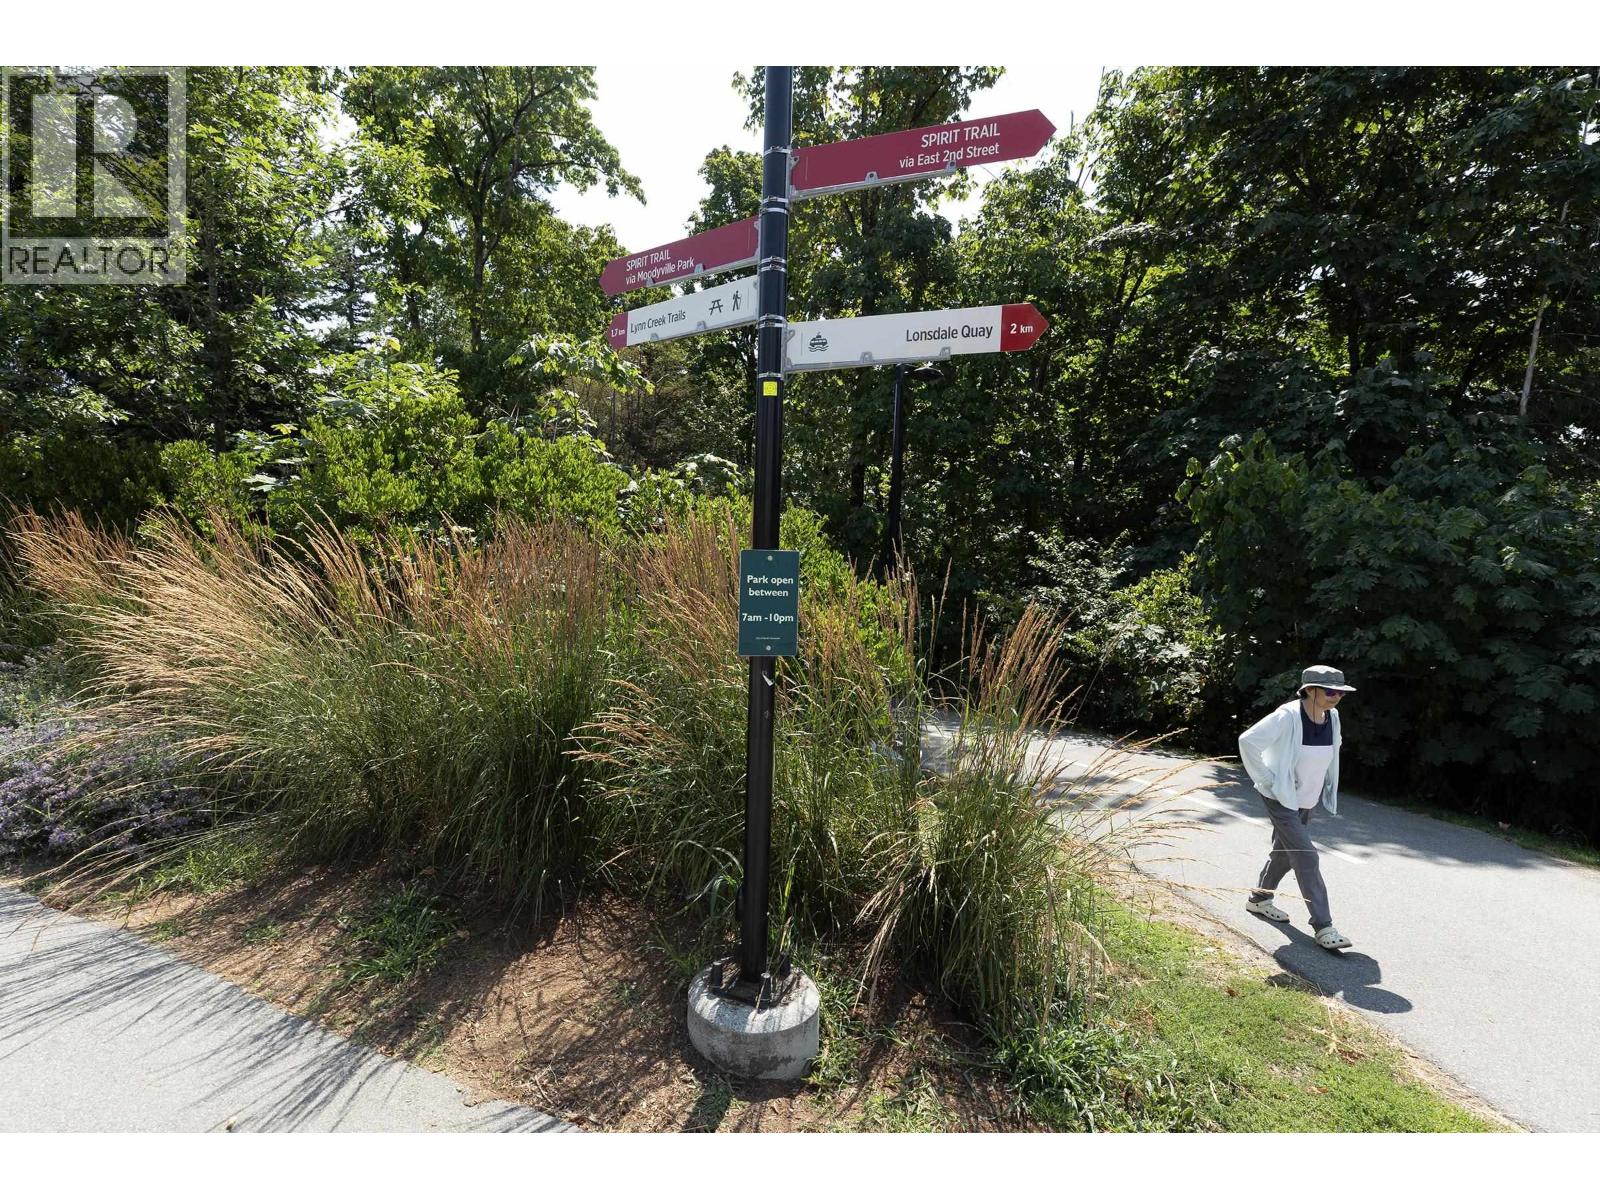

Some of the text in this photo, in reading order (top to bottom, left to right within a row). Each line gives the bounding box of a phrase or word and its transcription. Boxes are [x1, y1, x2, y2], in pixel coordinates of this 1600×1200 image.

[921, 123, 1000, 148] SPIRIT TRAIL
[899, 142, 1000, 169] via East 2nd Street
[626, 249, 671, 271] SPIRIT TRAIL
[625, 256, 695, 285] via Moodyville Park
[630, 309, 686, 335] Lynn Creek Trails
[1010, 323, 1034, 335] 2 km
[906, 324, 993, 343] Lonsdale Quay
[747, 575, 794, 586] Park open
[748, 588, 788, 596] between
[742, 613, 762, 622] 7am
